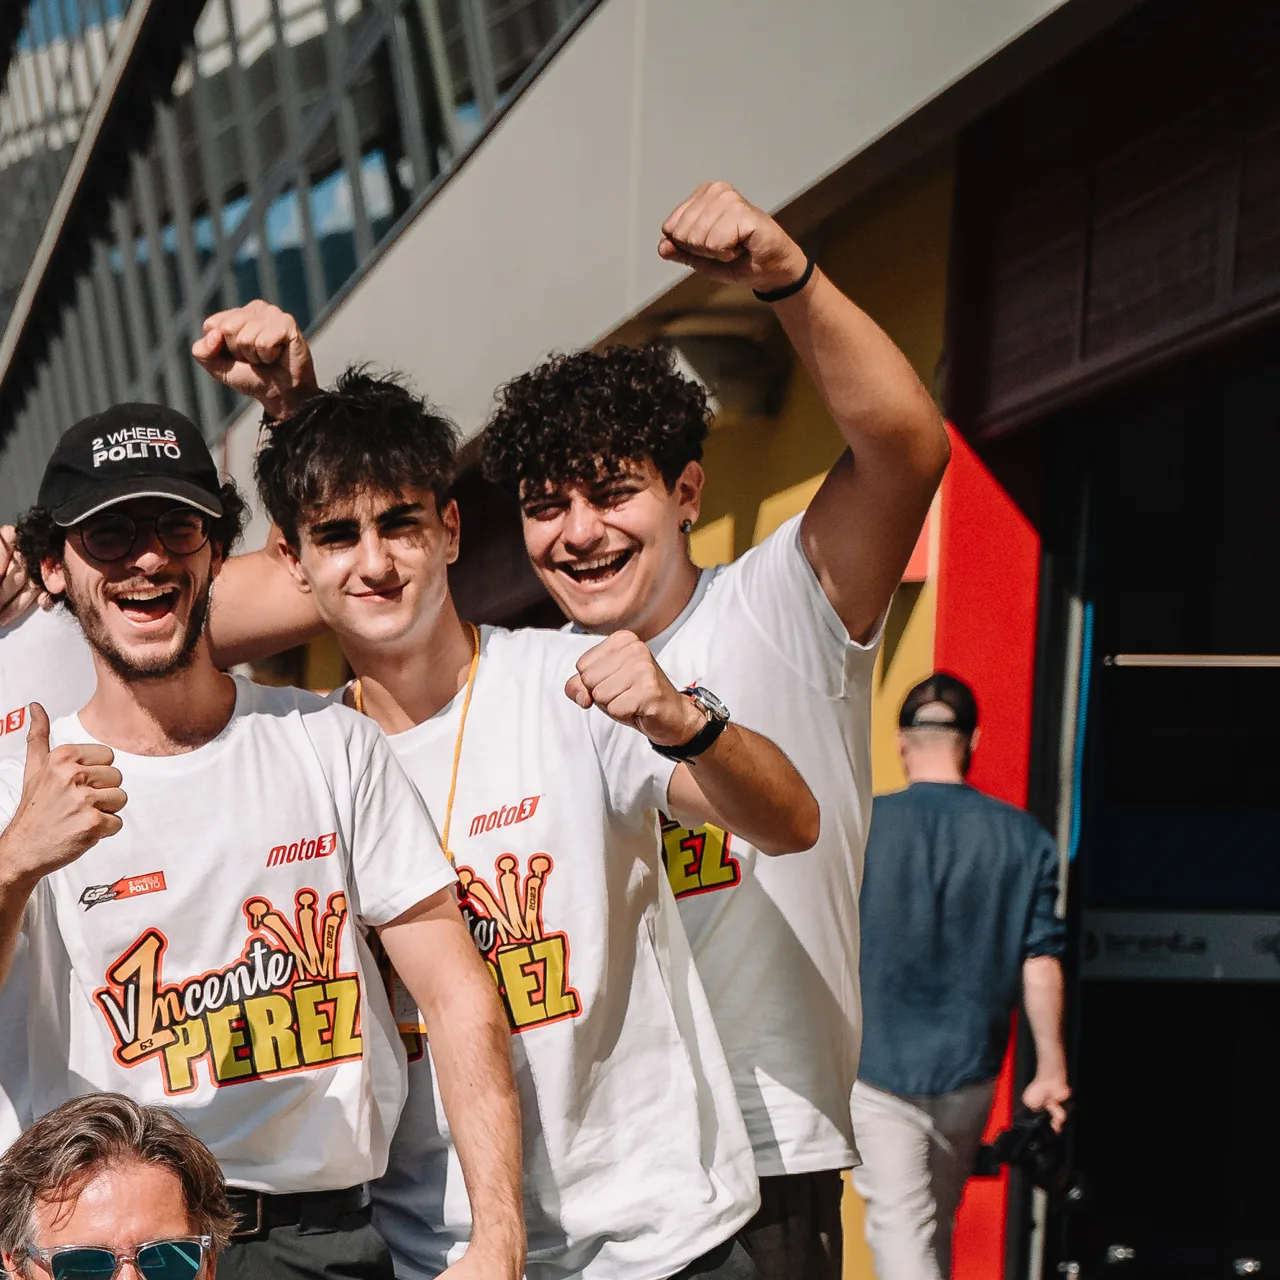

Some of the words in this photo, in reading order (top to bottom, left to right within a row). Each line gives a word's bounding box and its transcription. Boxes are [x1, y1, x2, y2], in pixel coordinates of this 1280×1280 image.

[92, 438, 104, 450] 2
[107, 427, 176, 446] WHEELS
[93, 443, 181, 468] POLITO
[469, 795, 541, 838] moto3
[267, 832, 337, 867] moto3
[129, 881, 161, 894] POLITO
[326, 924, 335, 949] 2023
[140, 1038, 153, 1050] 63
[165, 980, 362, 1091] PEREZ
